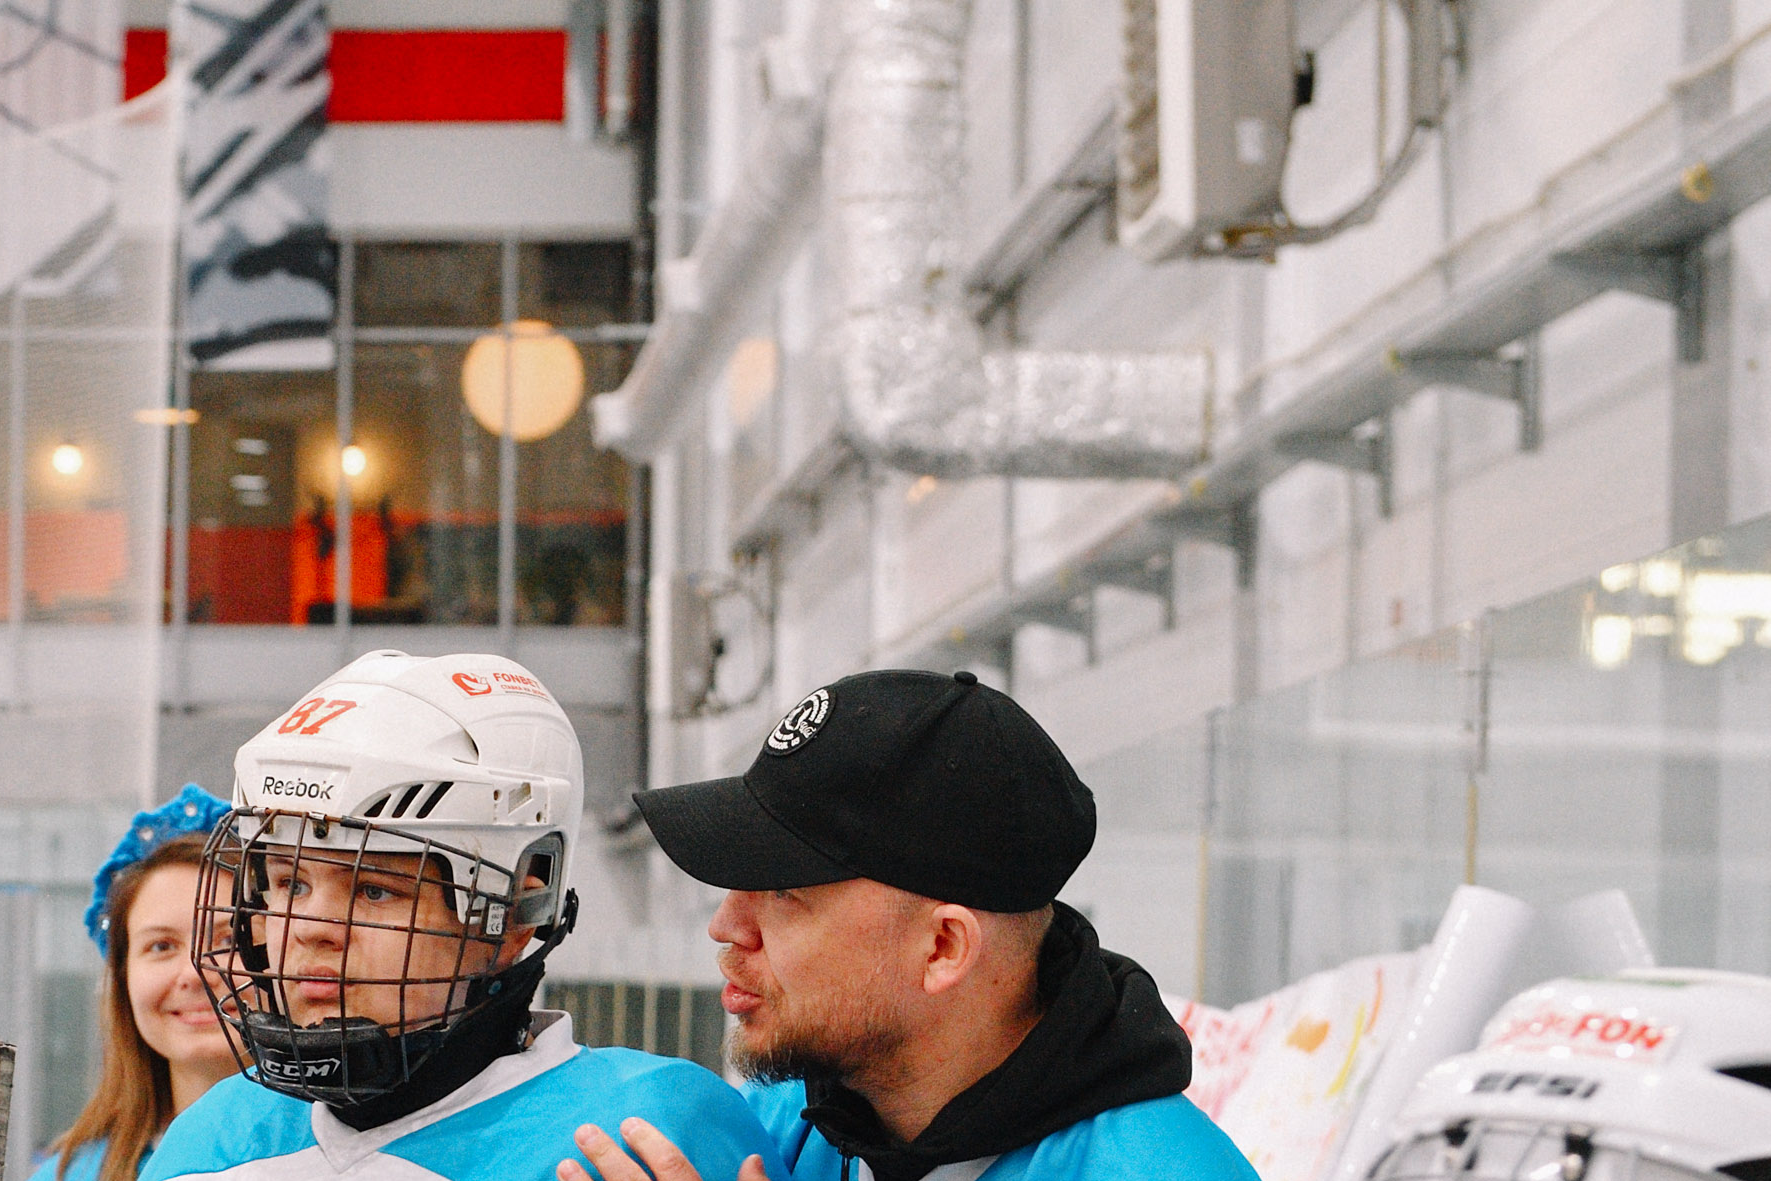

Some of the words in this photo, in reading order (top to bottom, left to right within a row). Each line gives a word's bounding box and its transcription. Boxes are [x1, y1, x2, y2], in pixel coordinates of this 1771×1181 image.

[277, 697, 357, 735] 87
[262, 776, 334, 800] Reebok
[264, 1059, 331, 1078] CCM
